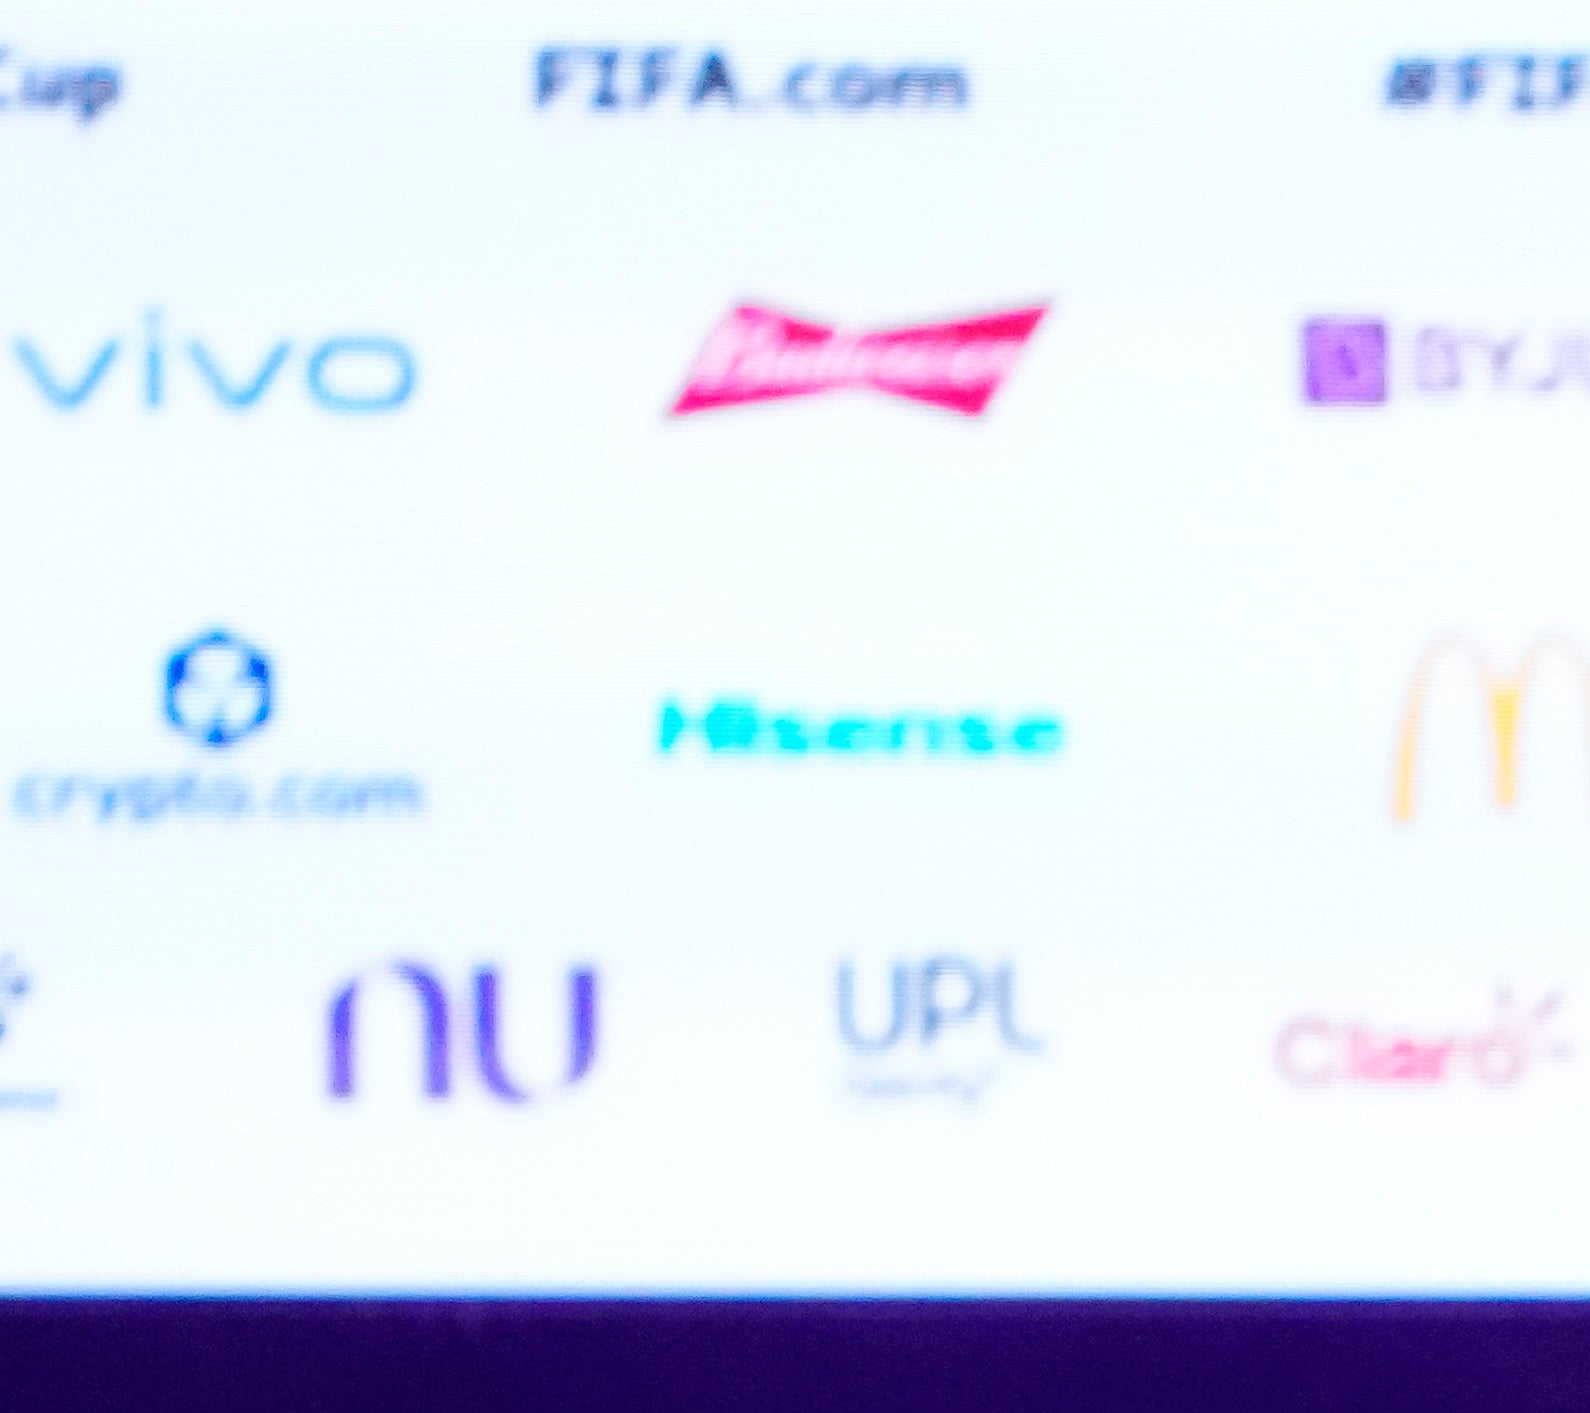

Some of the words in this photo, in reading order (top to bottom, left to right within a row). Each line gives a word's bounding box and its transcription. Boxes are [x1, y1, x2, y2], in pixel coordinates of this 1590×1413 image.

[0, 48, 124, 126] up
[533, 46, 969, 112] FIFA.com
[13, 308, 419, 415] vivo
[13, 770, 423, 825] crypto.com
[836, 953, 1045, 1055] UPL
[1275, 1010, 1530, 1087] Claro
